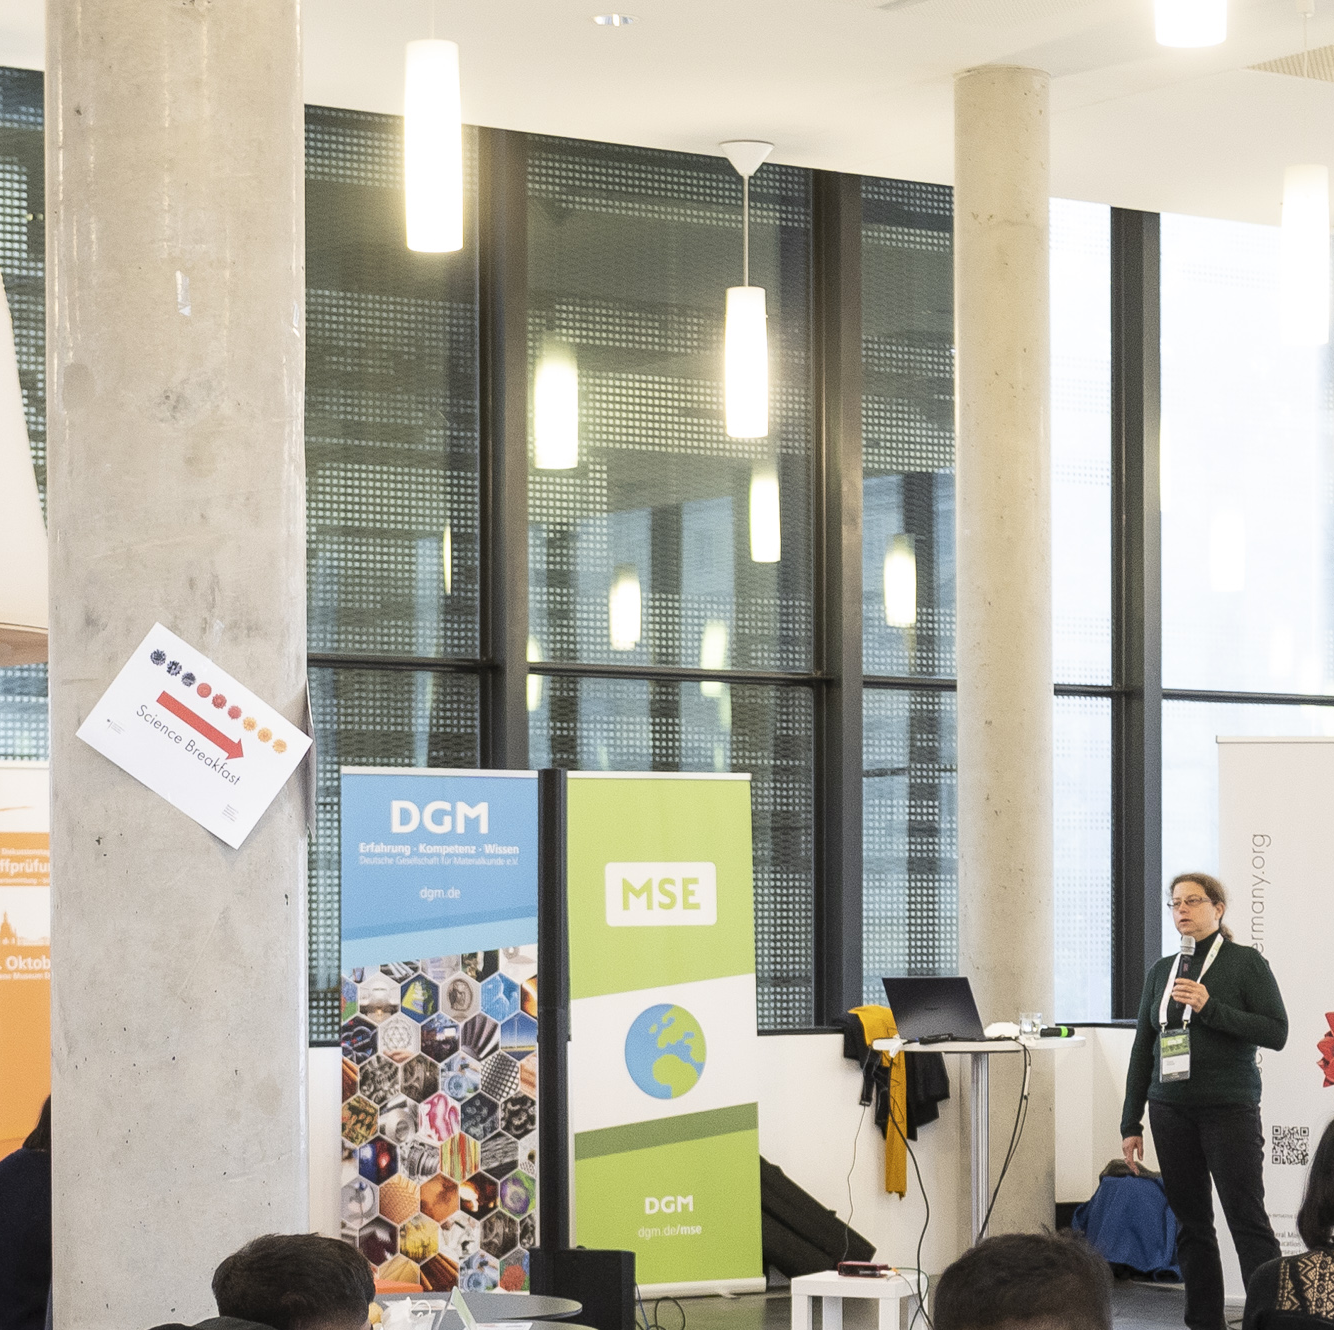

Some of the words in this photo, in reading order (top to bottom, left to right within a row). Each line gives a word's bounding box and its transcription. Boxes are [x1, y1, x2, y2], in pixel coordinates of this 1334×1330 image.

[136, 704, 183, 745] Science
[184, 739, 241, 786] Breakfast
[390, 800, 489, 834] DGM
[358, 842, 411, 856] Erfahrung
[419, 843, 477, 856] Kompetenz
[484, 843, 520, 855] Wissen
[419, 887, 462, 901] dgm.de
[622, 877, 701, 911] MSE
[1251, 833, 1272, 954] ermany.org
[6, 954, 50, 970] Oktob
[644, 1194, 694, 1215] DGM
[637, 1224, 703, 1240] dgm.de/mse
